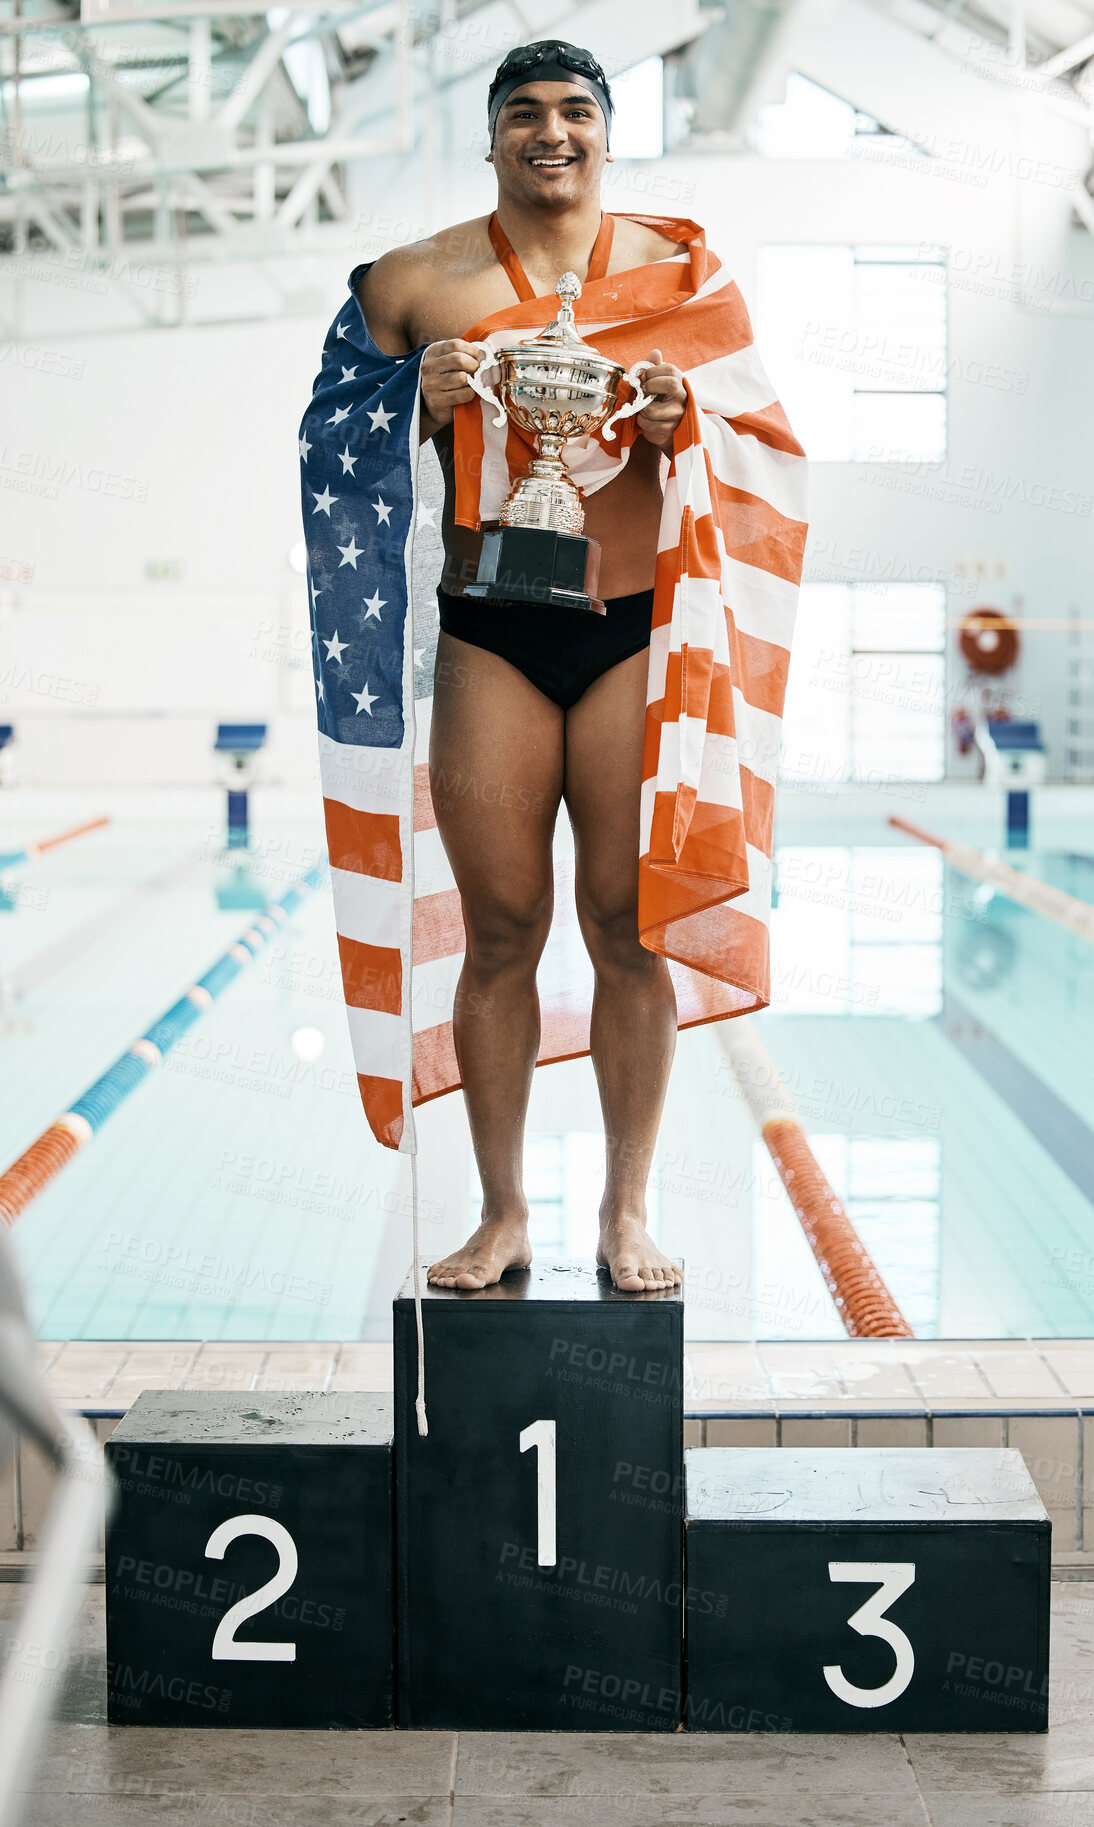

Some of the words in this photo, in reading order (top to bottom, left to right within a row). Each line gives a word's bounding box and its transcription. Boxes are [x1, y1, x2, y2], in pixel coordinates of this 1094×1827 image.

[520, 1420, 556, 1566] 1
[205, 1515, 297, 1661] 2
[823, 1562, 915, 1708] 3
